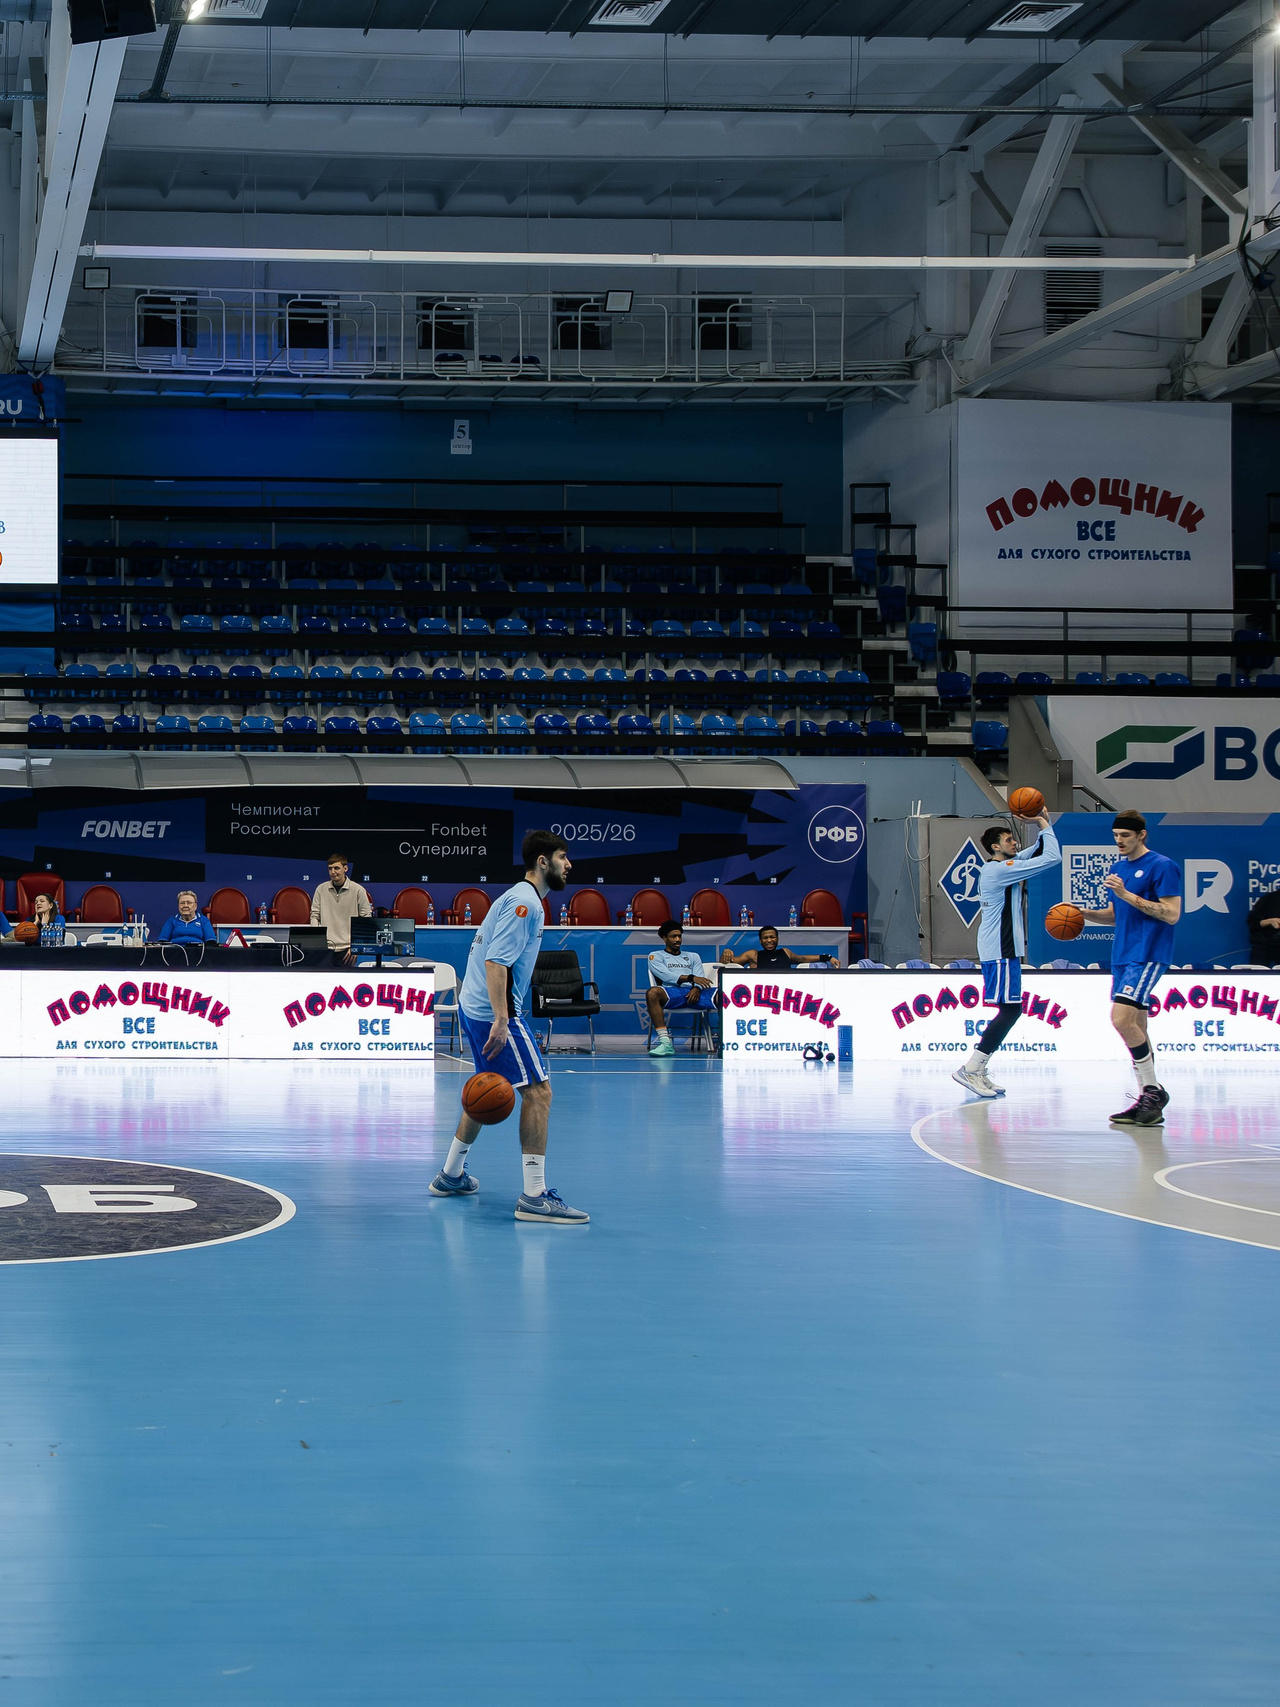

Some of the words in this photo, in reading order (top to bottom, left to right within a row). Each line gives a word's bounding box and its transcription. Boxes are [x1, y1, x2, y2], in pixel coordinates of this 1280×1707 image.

[456, 424, 466, 439] 5
[985, 476, 1206, 534] ПОМОЩНИК
[1076, 520, 1116, 541] ВСЕ
[997, 548, 1023, 560] ДЛЯ
[1031, 548, 1081, 560] СУХОГО
[1088, 549, 1191, 561] СТРОИТЕЛЬСТВА
[231, 803, 321, 816] Чемпионат
[81, 821, 171, 838] FONBET
[230, 822, 291, 835] России
[431, 823, 487, 836] Fonbet
[550, 823, 636, 842] 2025/26
[815, 826, 858, 842] РФБ
[399, 842, 487, 858] Суперлига
[46, 981, 231, 1027] ПОМОЩНИК
[722, 984, 841, 1029] ОЩНИК
[891, 984, 1068, 1029] ПОМОИК
[1148, 985, 1280, 1025] ОМОЩНИ
[122, 1017, 156, 1034] ВСЕ
[358, 1018, 391, 1036] ВСЕ
[736, 1019, 768, 1036] ВСЕ
[965, 1019, 992, 1036] ВС
[1193, 1020, 1225, 1036] ВСЕ
[56, 1040, 78, 1050] ДЛЯ
[84, 1040, 125, 1050] СУХОГО
[131, 1041, 218, 1050] СТРОИТЕЛЬСТВА
[293, 1042, 314, 1051] ДЛЯ
[320, 1042, 361, 1051] СУХОГО
[367, 1042, 433, 1051] СТРОИТЕЛЬС
[901, 1043, 922, 1052] ДЛЯ
[928, 1042, 968, 1051] СУХОГО
[1157, 1043, 1196, 1052] СУХОГО
